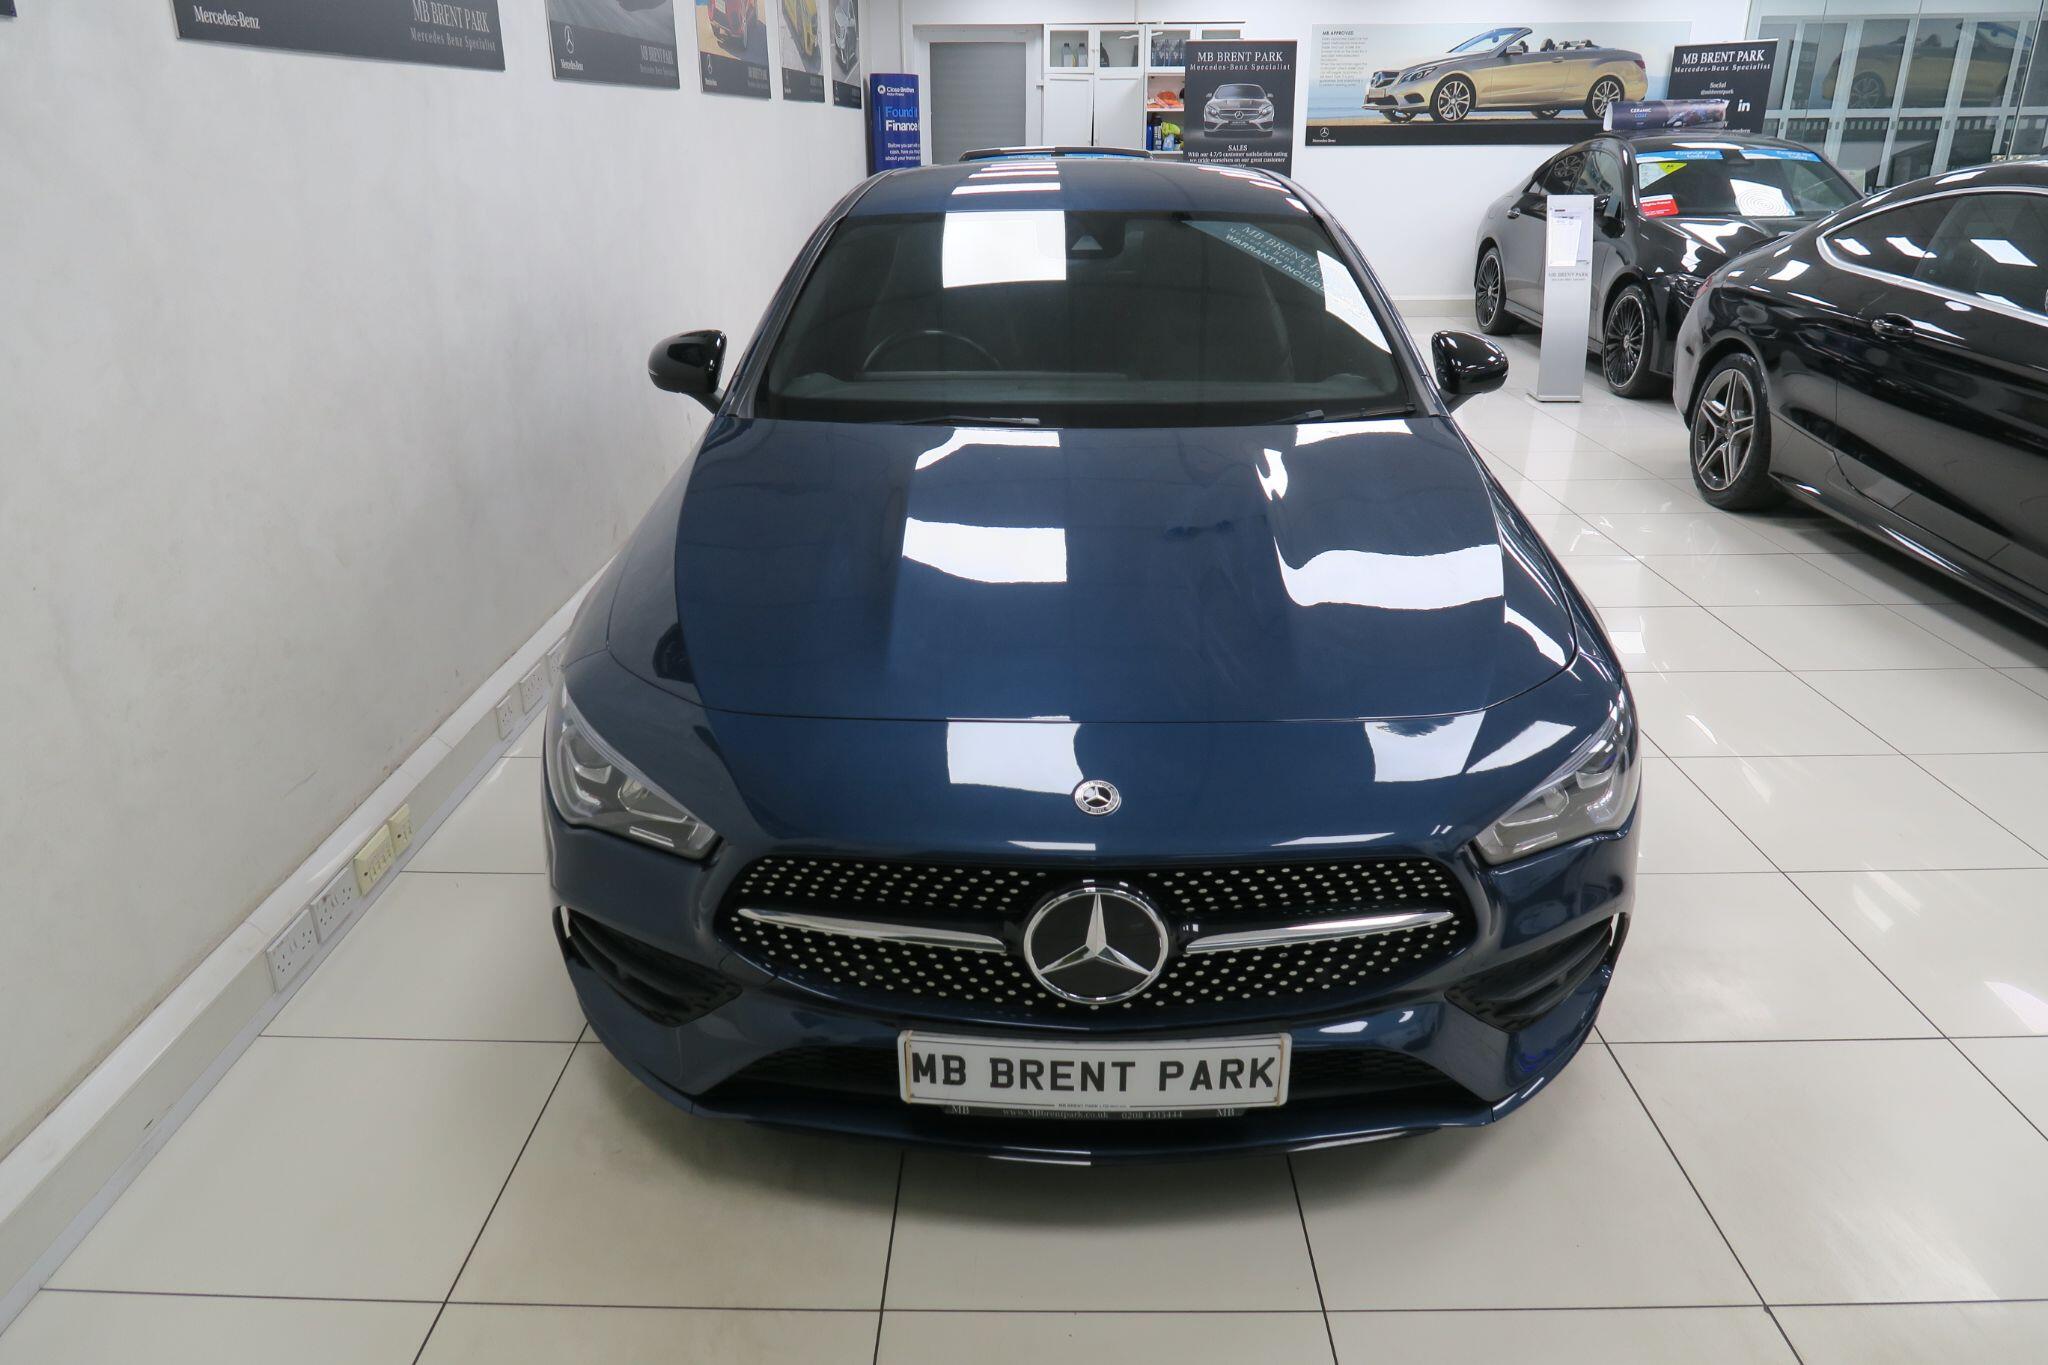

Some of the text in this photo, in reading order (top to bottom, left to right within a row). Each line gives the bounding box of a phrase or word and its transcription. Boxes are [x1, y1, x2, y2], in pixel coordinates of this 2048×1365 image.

[193, 4, 261, 29] Mercedes-Benz
[412, 0, 490, 33] MB BRENT PARK
[1197, 52, 1283, 62] MB BRENT PARK
[1682, 50, 1765, 65] MB BRENT PARK
[1251, 64, 1290, 72] Specialist
[1674, 63, 1771, 73] Mercedes-Benz Specialist
[886, 106, 914, 118] Found
[885, 120, 918, 132] Finance
[1226, 234, 1283, 266] WARRANTY
[1242, 226, 1265, 240] MB
[1265, 238, 1312, 265] BRENT
[913, 1053, 1276, 1092] MB BRENT PARK
[951, 1104, 969, 1115] MB
[1216, 1108, 1235, 1117] MB
